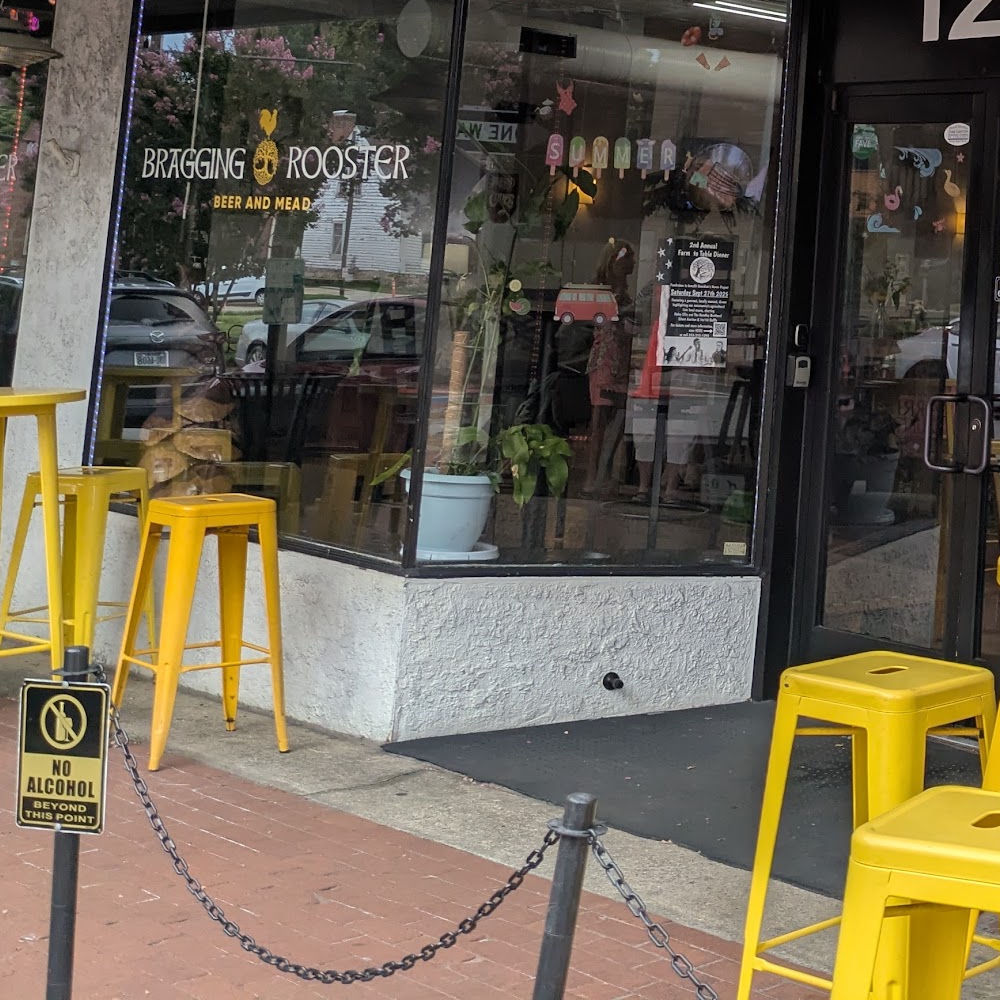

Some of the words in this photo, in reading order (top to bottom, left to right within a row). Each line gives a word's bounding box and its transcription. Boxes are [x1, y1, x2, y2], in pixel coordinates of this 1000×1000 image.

[142, 147, 247, 180] BRAGGING
[286, 145, 411, 180] ROOSTER
[549, 142, 674, 165] SUMMER
[213, 195, 242, 210] BEER
[245, 195, 271, 210] AND
[275, 196, 311, 211] MEAD
[52, 759, 71, 777] NO
[26, 777, 95, 798] ALCOHOL
[34, 801, 86, 813] BEYOND
[25, 810, 53, 820] THIS
[56, 813, 95, 824] POINT
